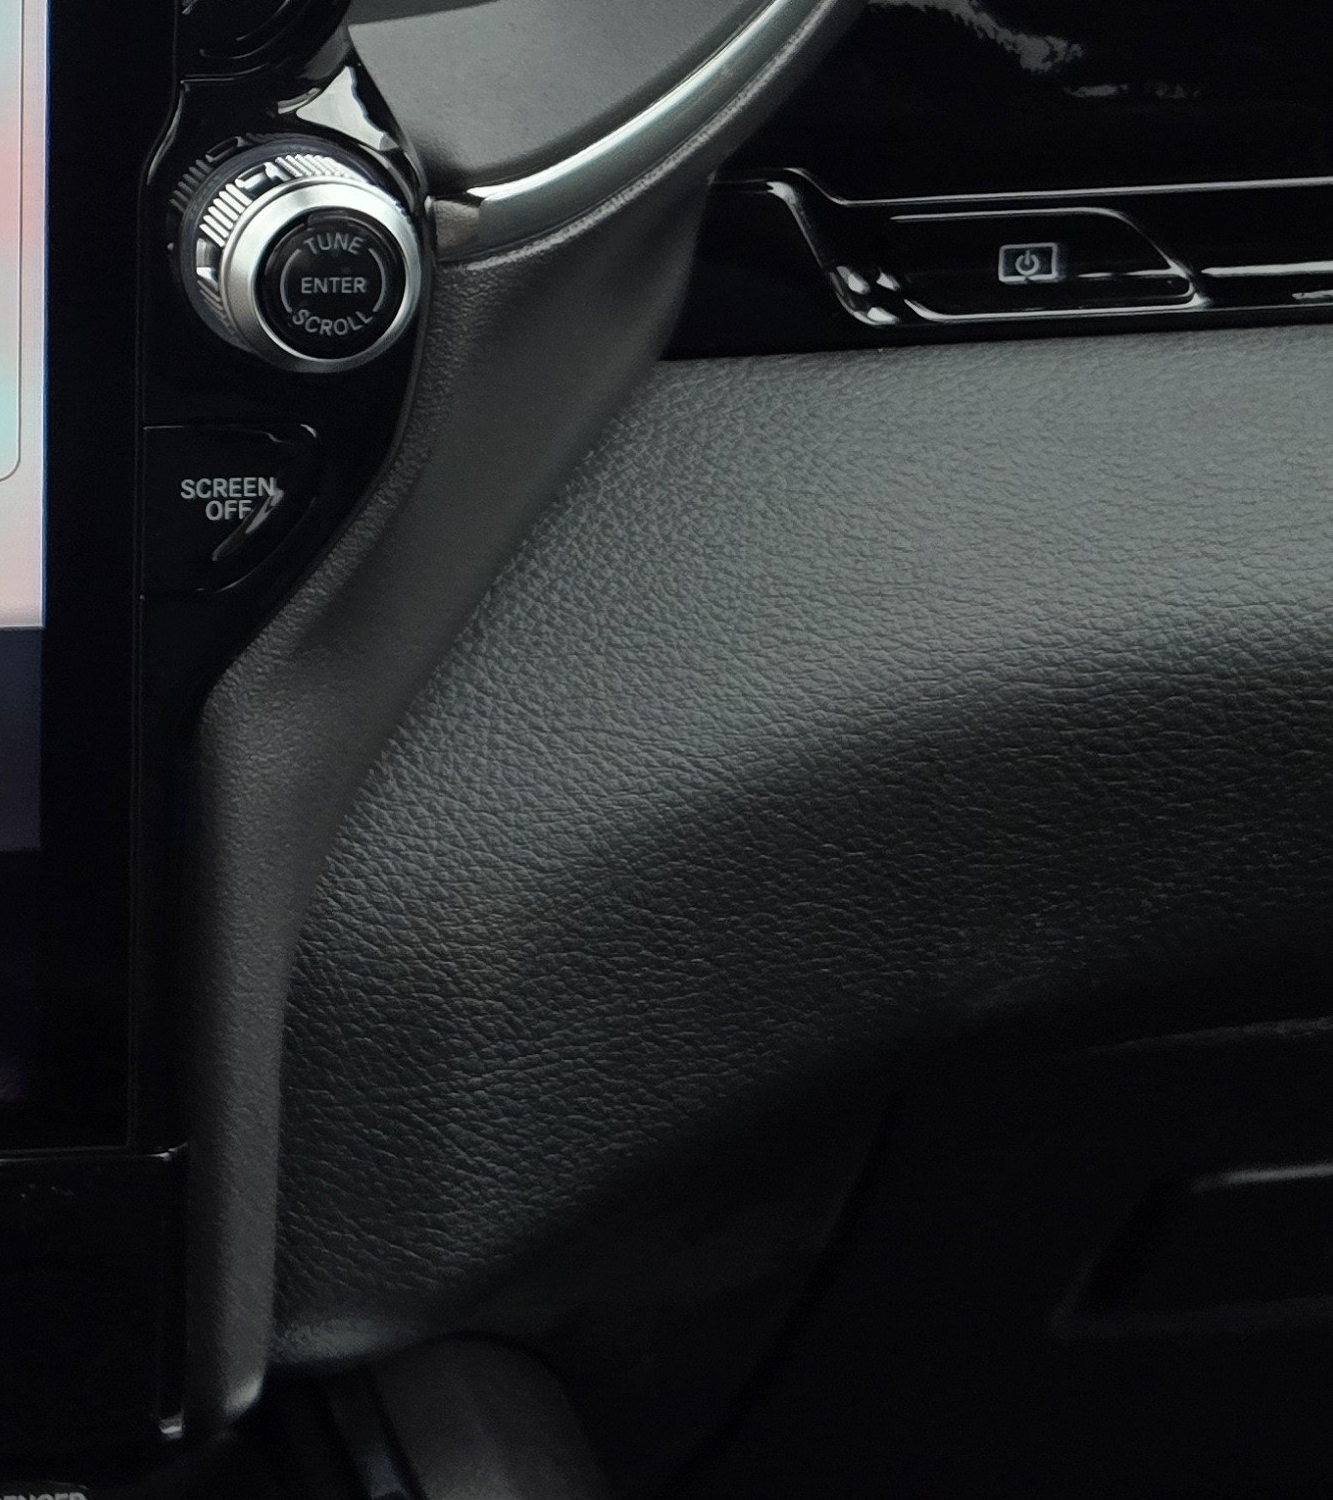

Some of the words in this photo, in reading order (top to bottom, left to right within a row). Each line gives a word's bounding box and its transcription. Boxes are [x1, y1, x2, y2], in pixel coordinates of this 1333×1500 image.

[304, 232, 365, 256] TUNE
[301, 275, 366, 295] ENTER
[291, 306, 373, 336] SCROLL
[180, 478, 276, 500] SCREEN
[206, 500, 252, 521] OFF
